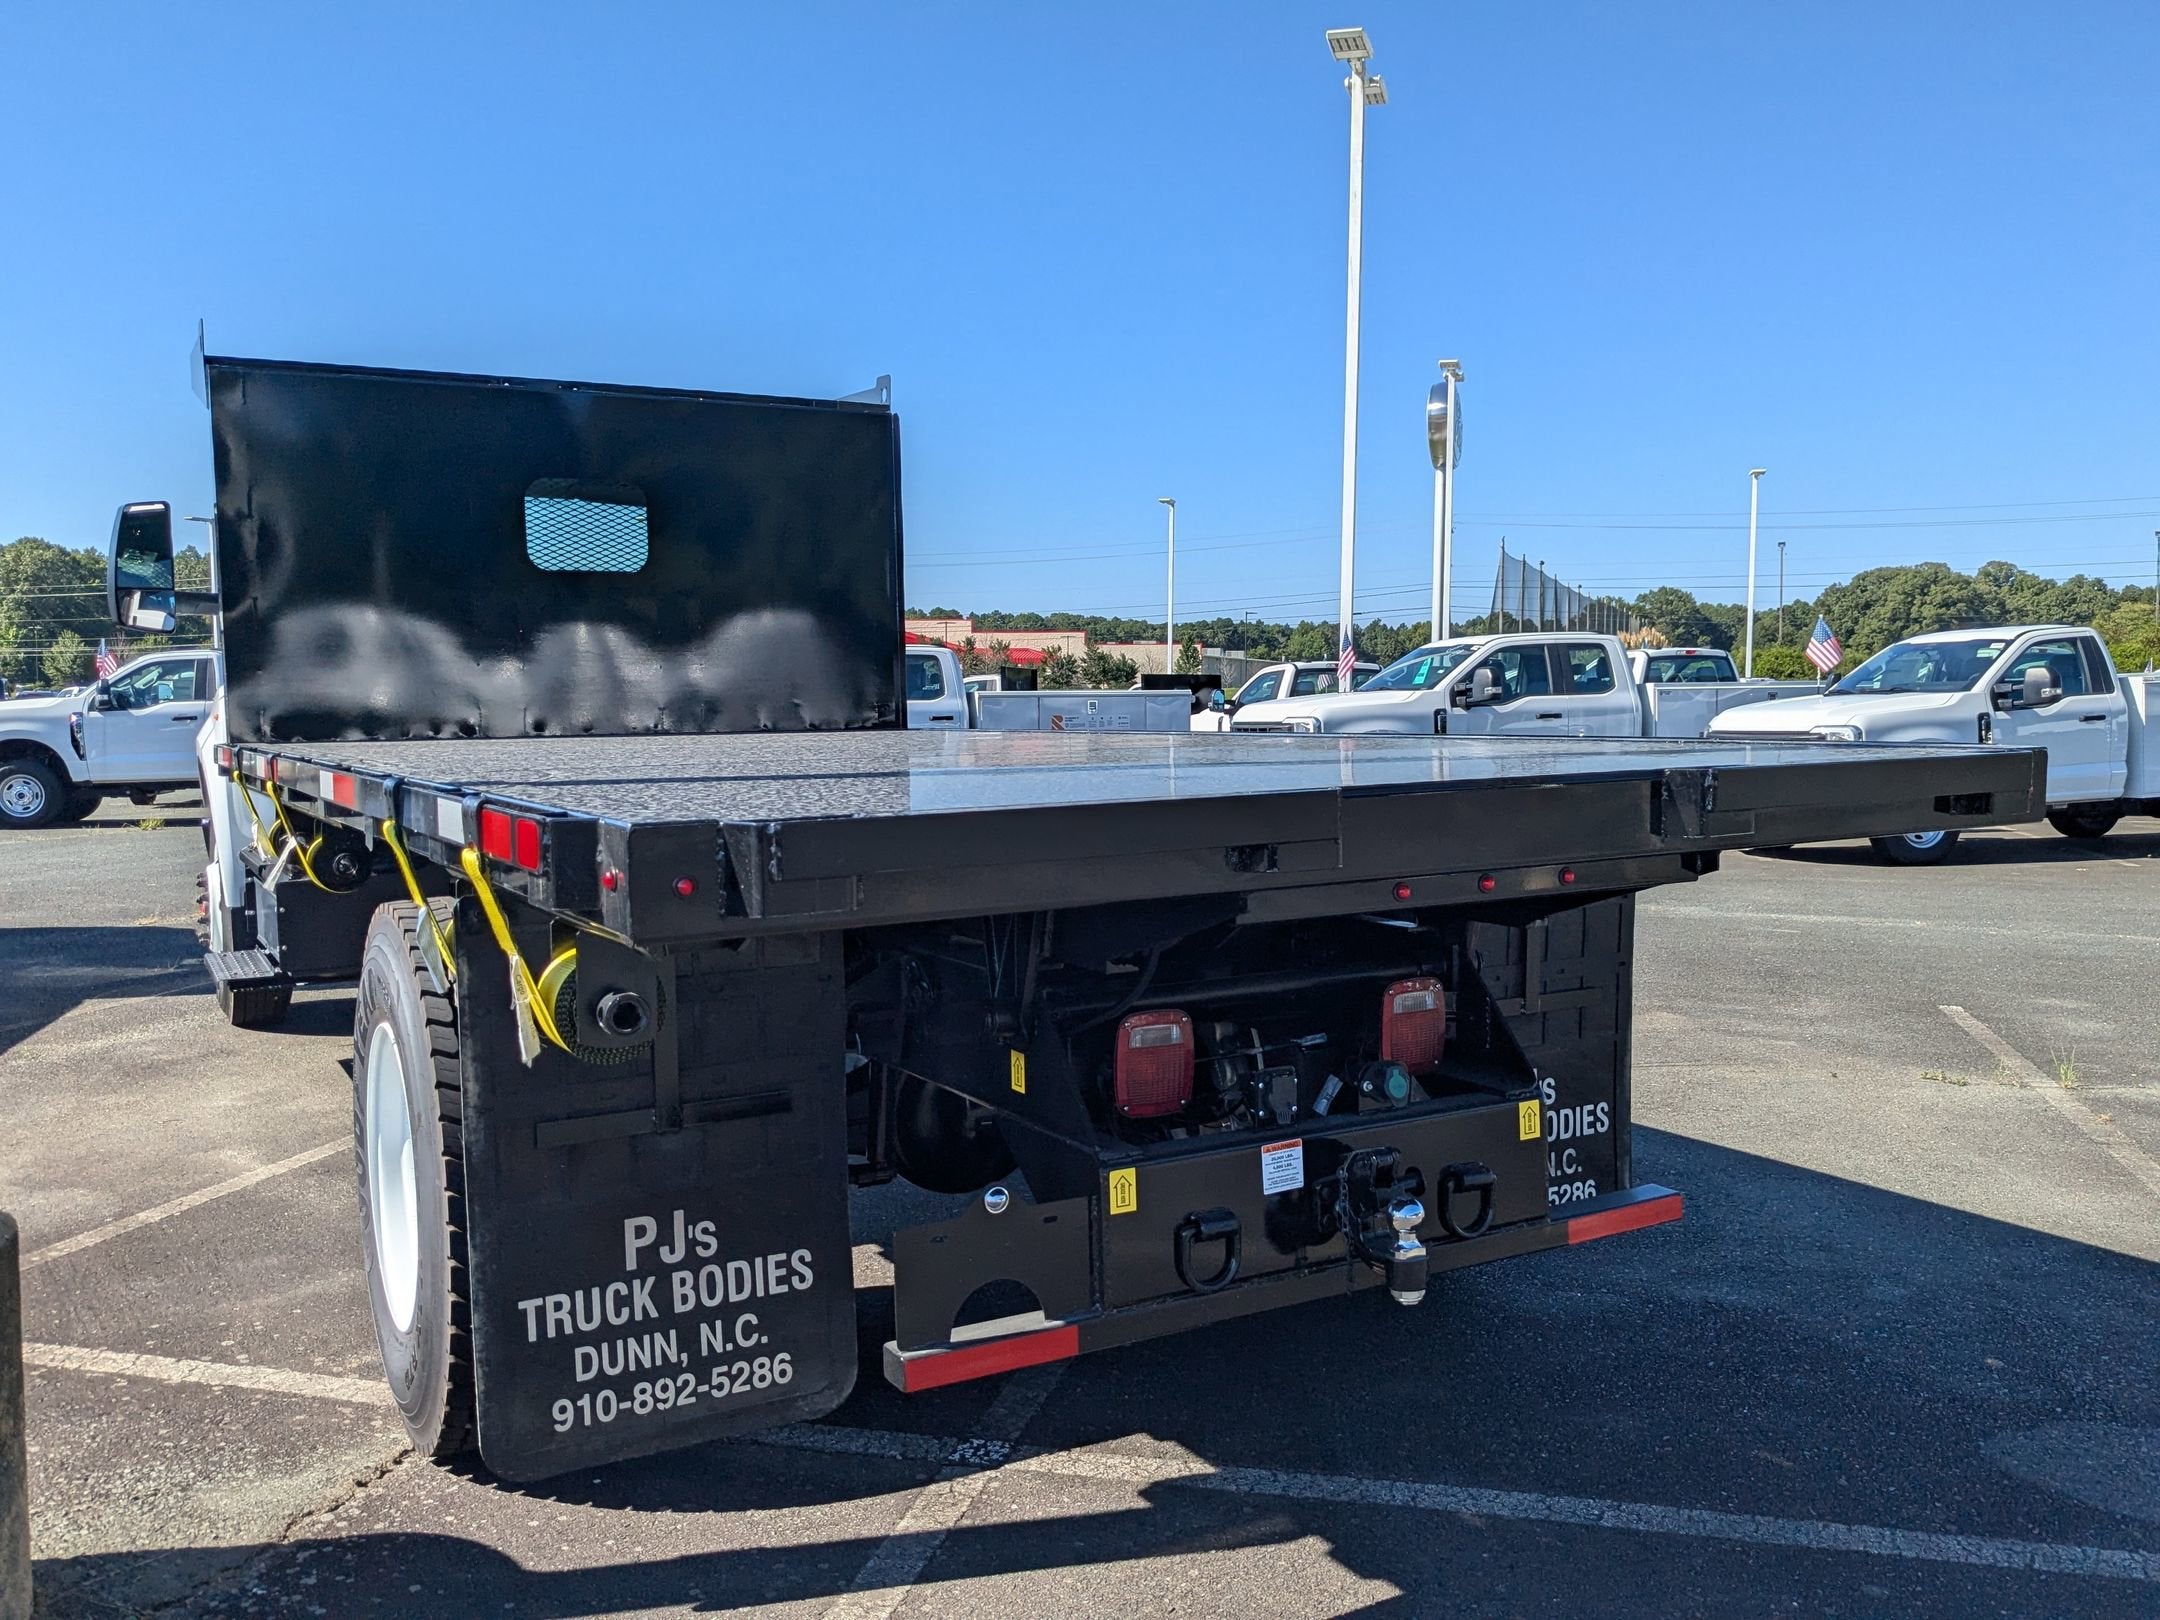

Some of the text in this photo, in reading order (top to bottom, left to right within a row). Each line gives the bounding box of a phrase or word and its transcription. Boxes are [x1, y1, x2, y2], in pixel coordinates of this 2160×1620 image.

[1547, 1101, 1610, 1142] ODIES
[518, 1248, 814, 1342] TRUCK BODIES
[574, 1313, 769, 1382] DUNN, N.C.
[551, 1352, 794, 1433] 910-892-5286
